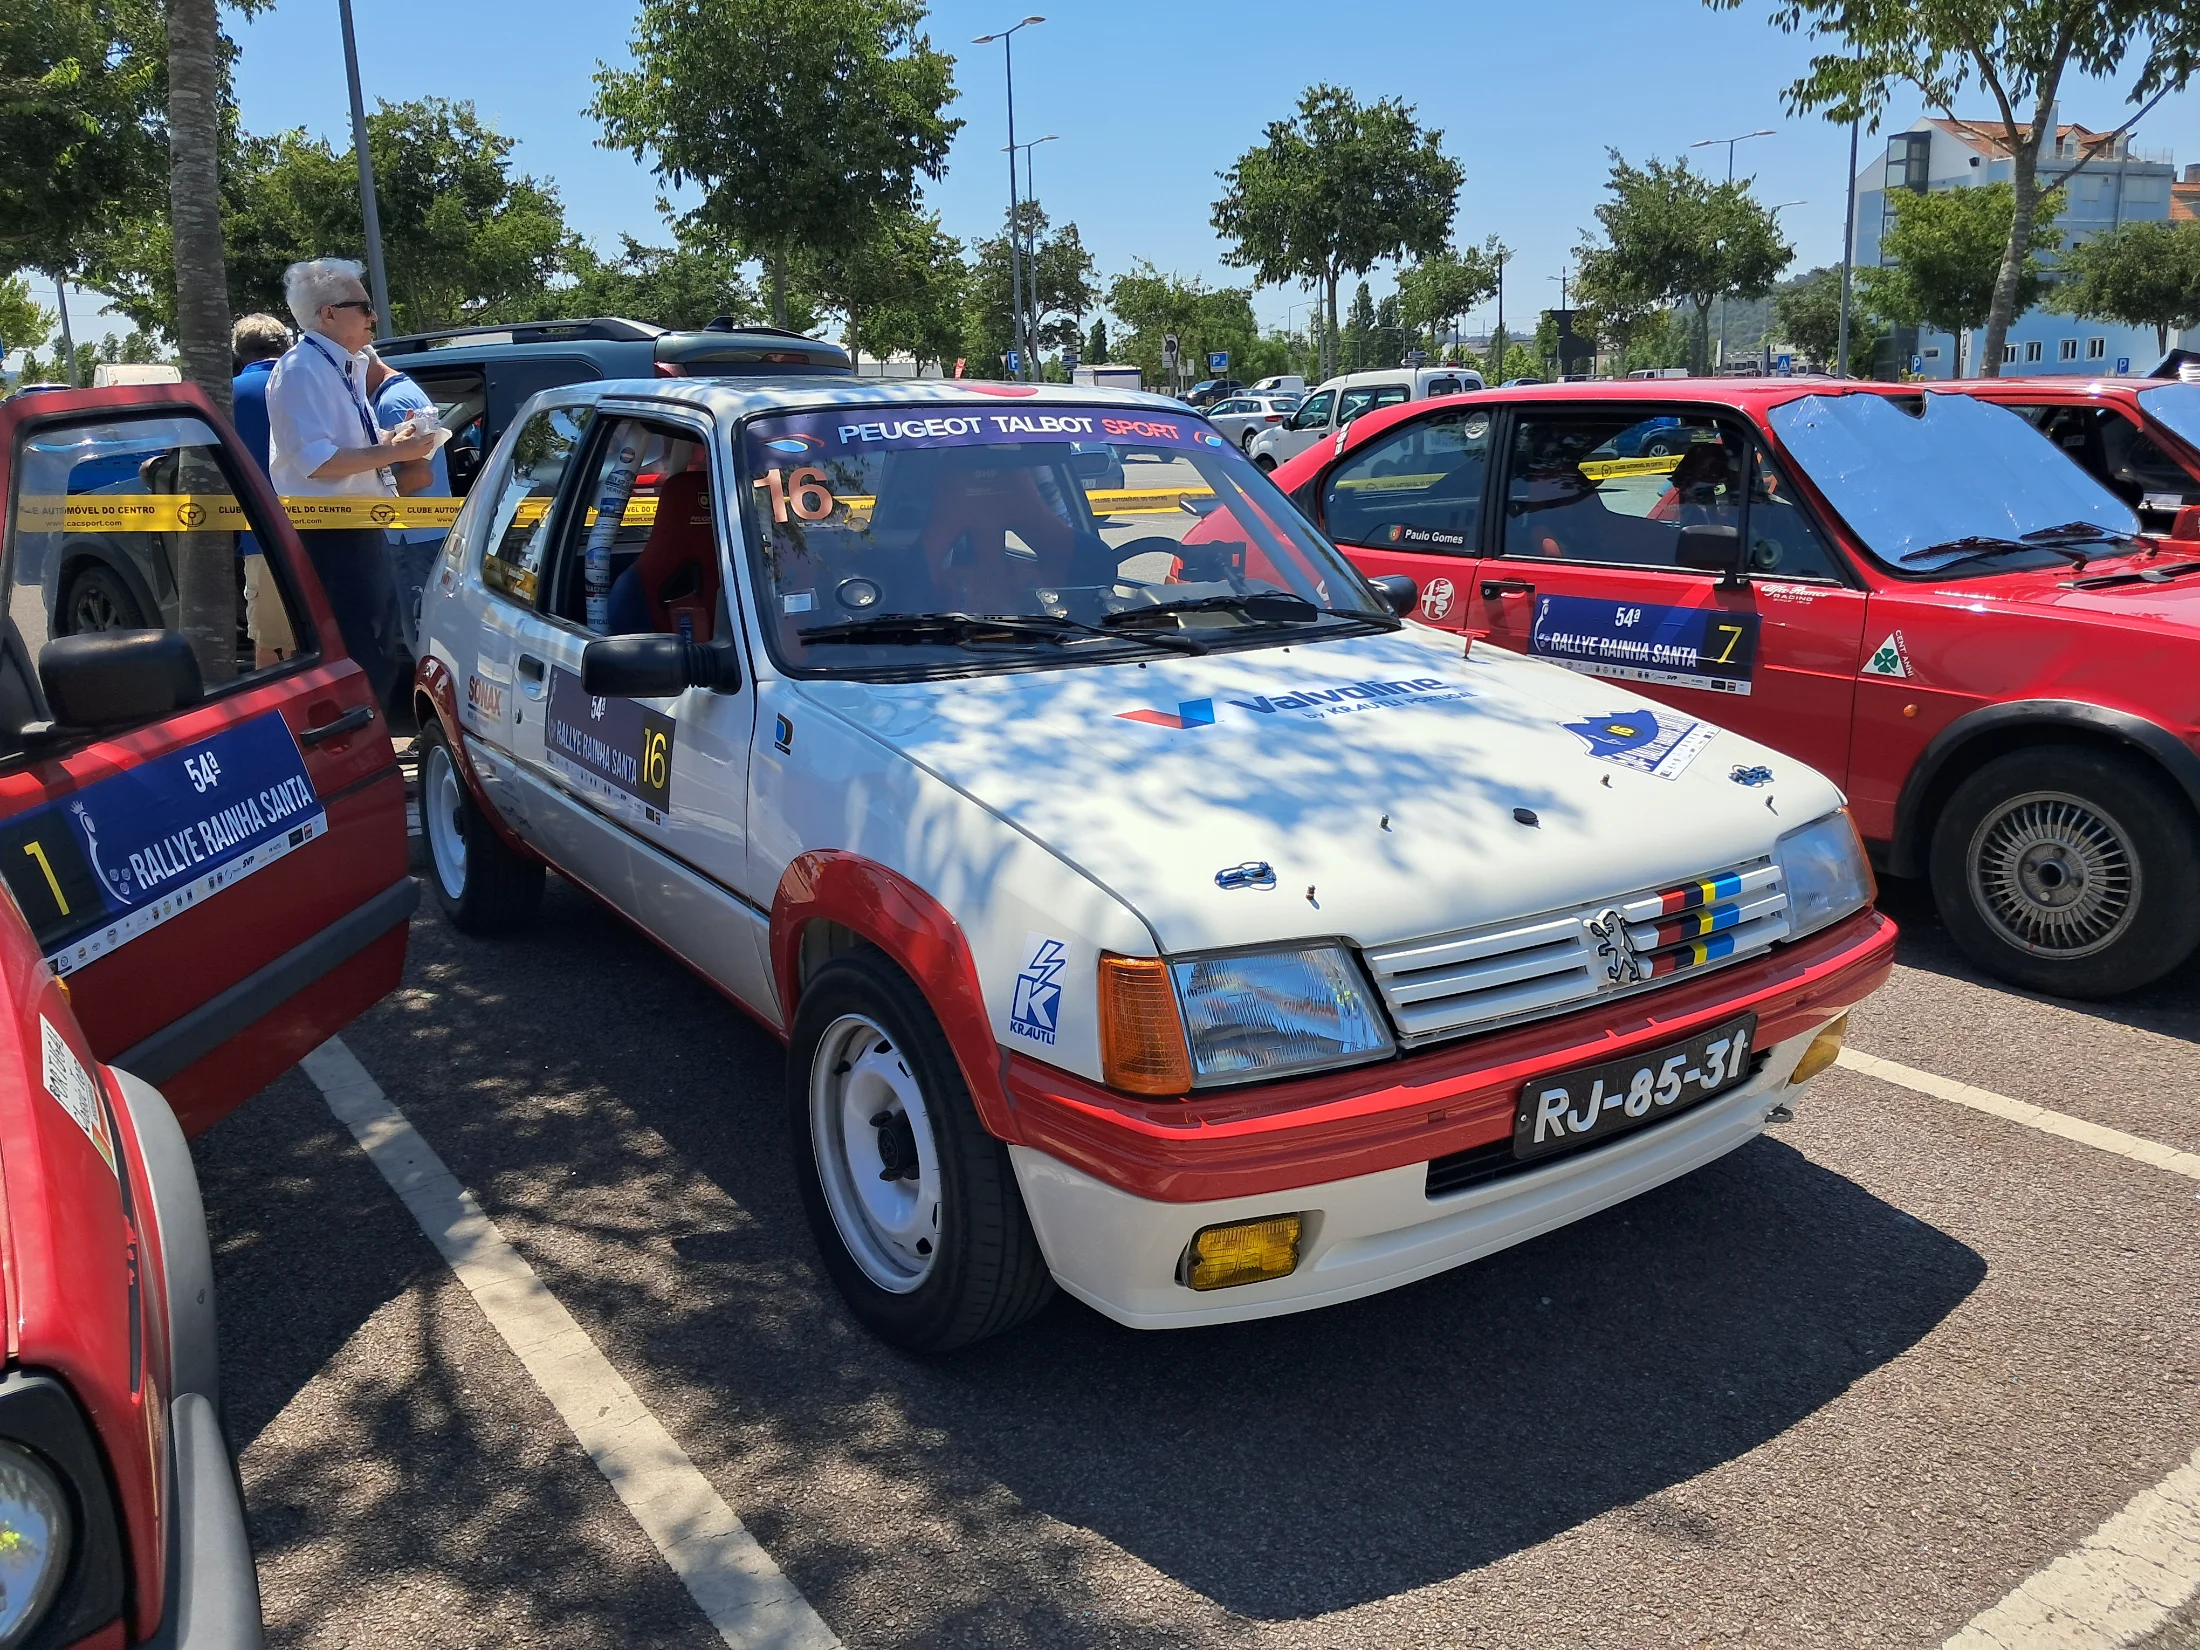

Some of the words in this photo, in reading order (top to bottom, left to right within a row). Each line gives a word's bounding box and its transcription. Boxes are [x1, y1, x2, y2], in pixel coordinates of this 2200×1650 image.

[837, 416, 982, 445] PEUGEOT
[989, 416, 1093, 433] TALBOT
[1101, 419, 1180, 440] SPORT
[102, 506, 115, 514] DO
[118, 506, 156, 514] CENTRO
[218, 506, 243, 514] CLUB
[304, 506, 316, 514] DO
[318, 505, 352, 513] CENTRO
[407, 506, 432, 514] CLUBE
[753, 467, 833, 523] 16
[1405, 529, 1430, 541] Paulo
[1431, 532, 1464, 545] Gomes
[1773, 593, 1814, 602] RACING
[1550, 632, 1597, 656] RALLYE
[1600, 637, 1649, 662] RAINHA
[1651, 643, 1698, 668] SANTA
[1717, 624, 1743, 665] 7
[1902, 656, 1914, 677] ANNI
[468, 675, 502, 717] SONAX
[1229, 678, 1451, 714] Valvoline
[1325, 699, 1403, 716] KRAUTLI
[1404, 691, 1479, 705] PORTUGAL
[556, 720, 582, 755] RALLYE
[582, 733, 611, 770] RAINHA
[612, 749, 637, 786] SANTA
[644, 727, 666, 789] 16
[128, 827, 205, 890] RALLYE
[197, 798, 266, 855] RAINHA
[260, 774, 313, 823] SANTA
[23, 841, 70, 916] 1
[1009, 1020, 1056, 1045] KRAUTLI
[1533, 1029, 1747, 1143] RJ-85-31
